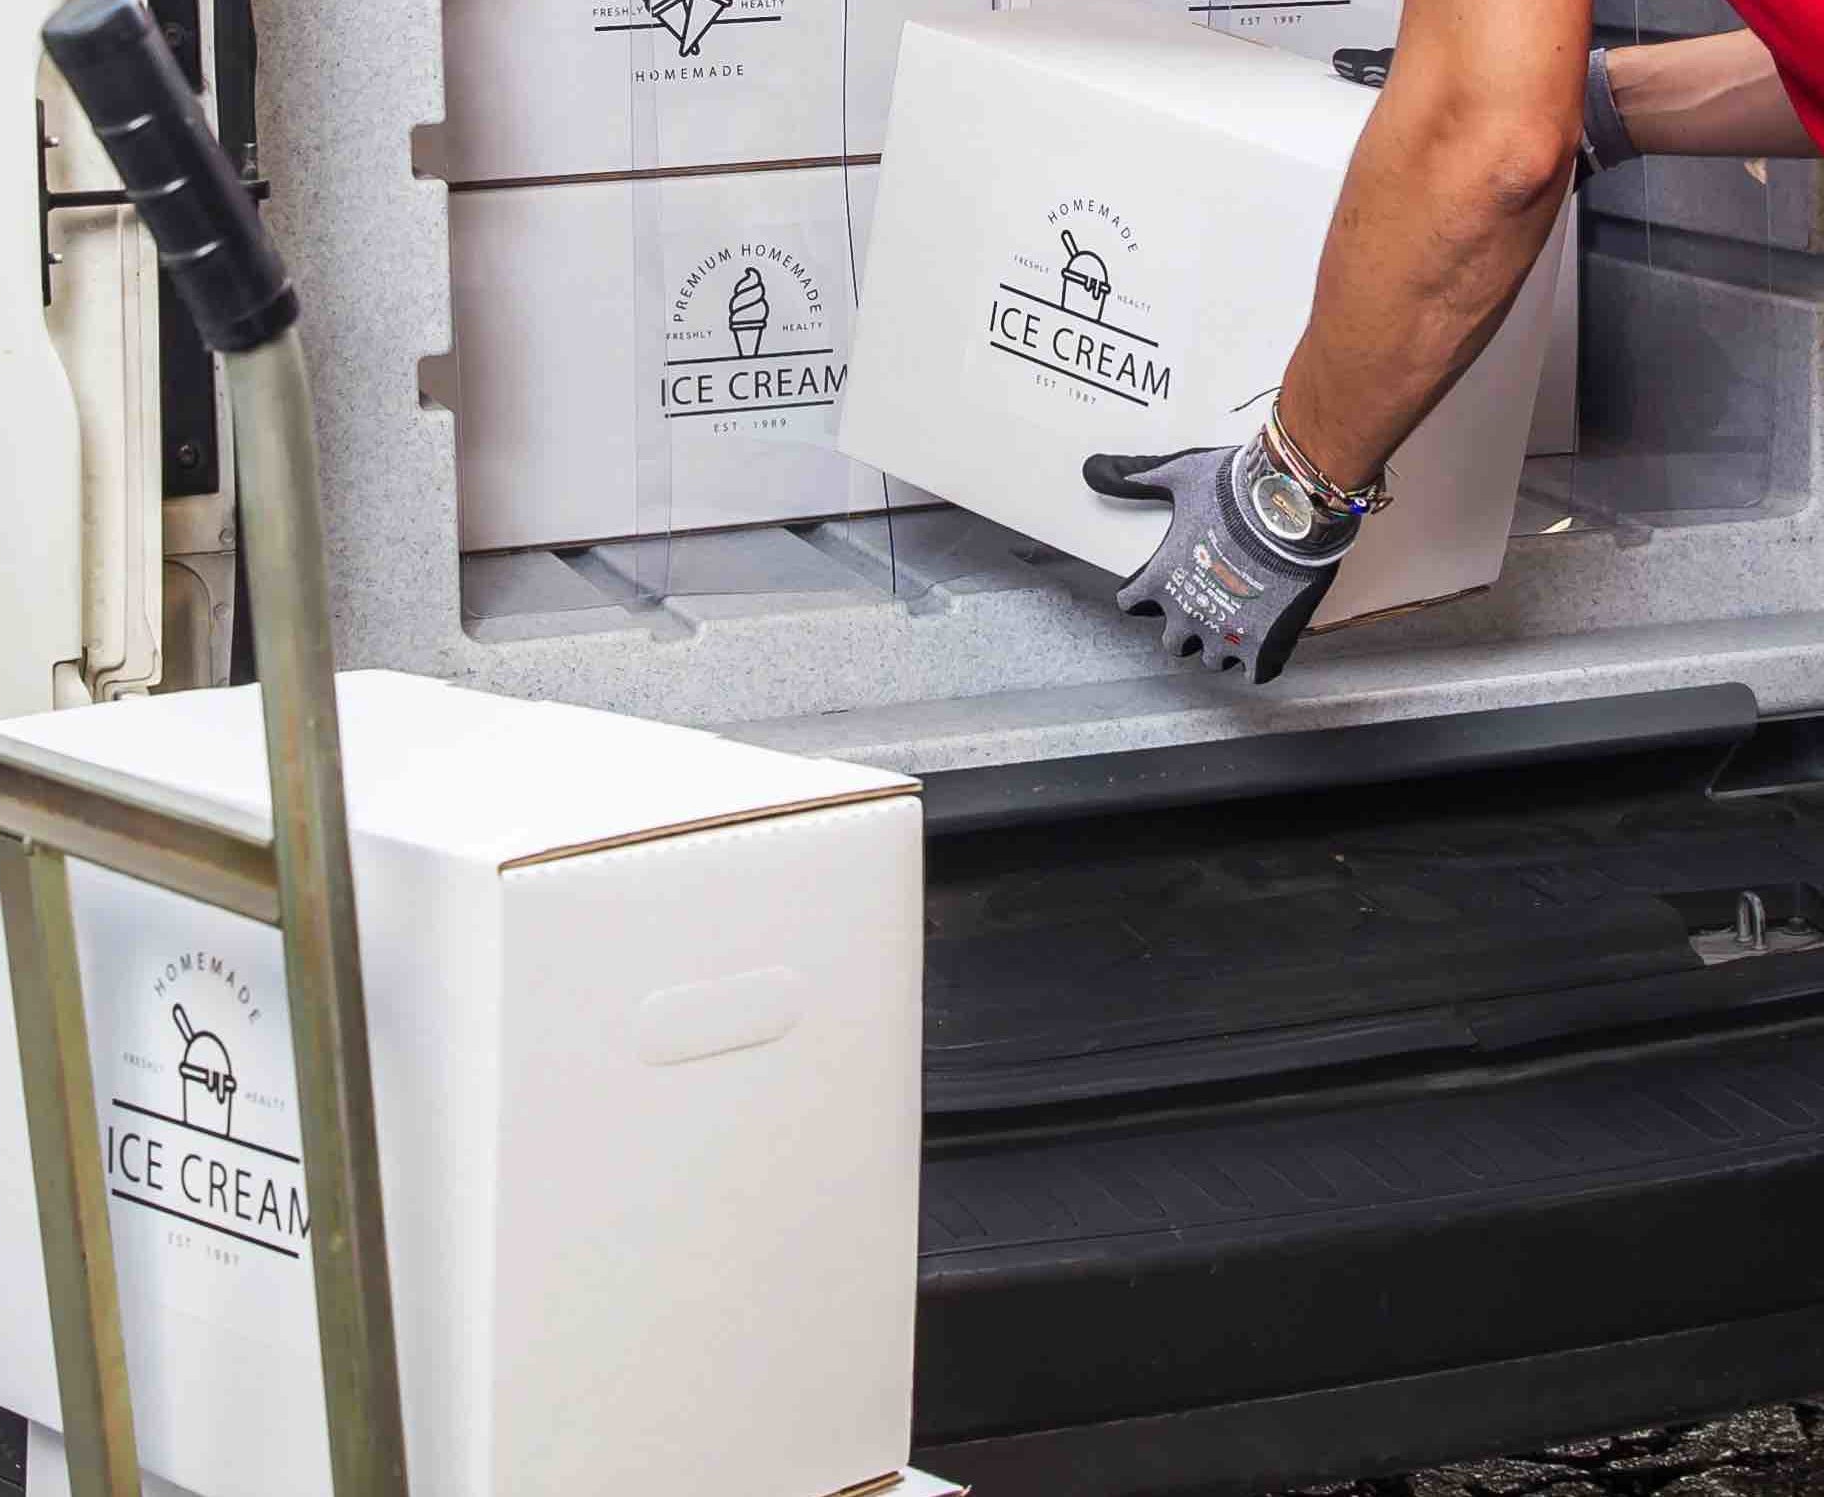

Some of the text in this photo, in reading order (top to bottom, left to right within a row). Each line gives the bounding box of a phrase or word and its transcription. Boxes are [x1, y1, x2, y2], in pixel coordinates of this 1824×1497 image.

[592, 6, 644, 17] FRESHLY
[635, 65, 744, 83] HOMEMADE
[1048, 199, 1138, 253] HOMEMADE
[673, 243, 822, 323] PREMIUM HOMEMADE
[666, 330, 713, 340] FRESHLY
[782, 322, 823, 332] HEALTY
[989, 300, 1171, 400] ICE CREAM
[661, 364, 848, 407] ICE CREAM
[154, 952, 261, 1025] HOMEMADE
[108, 1126, 163, 1191] ICE
